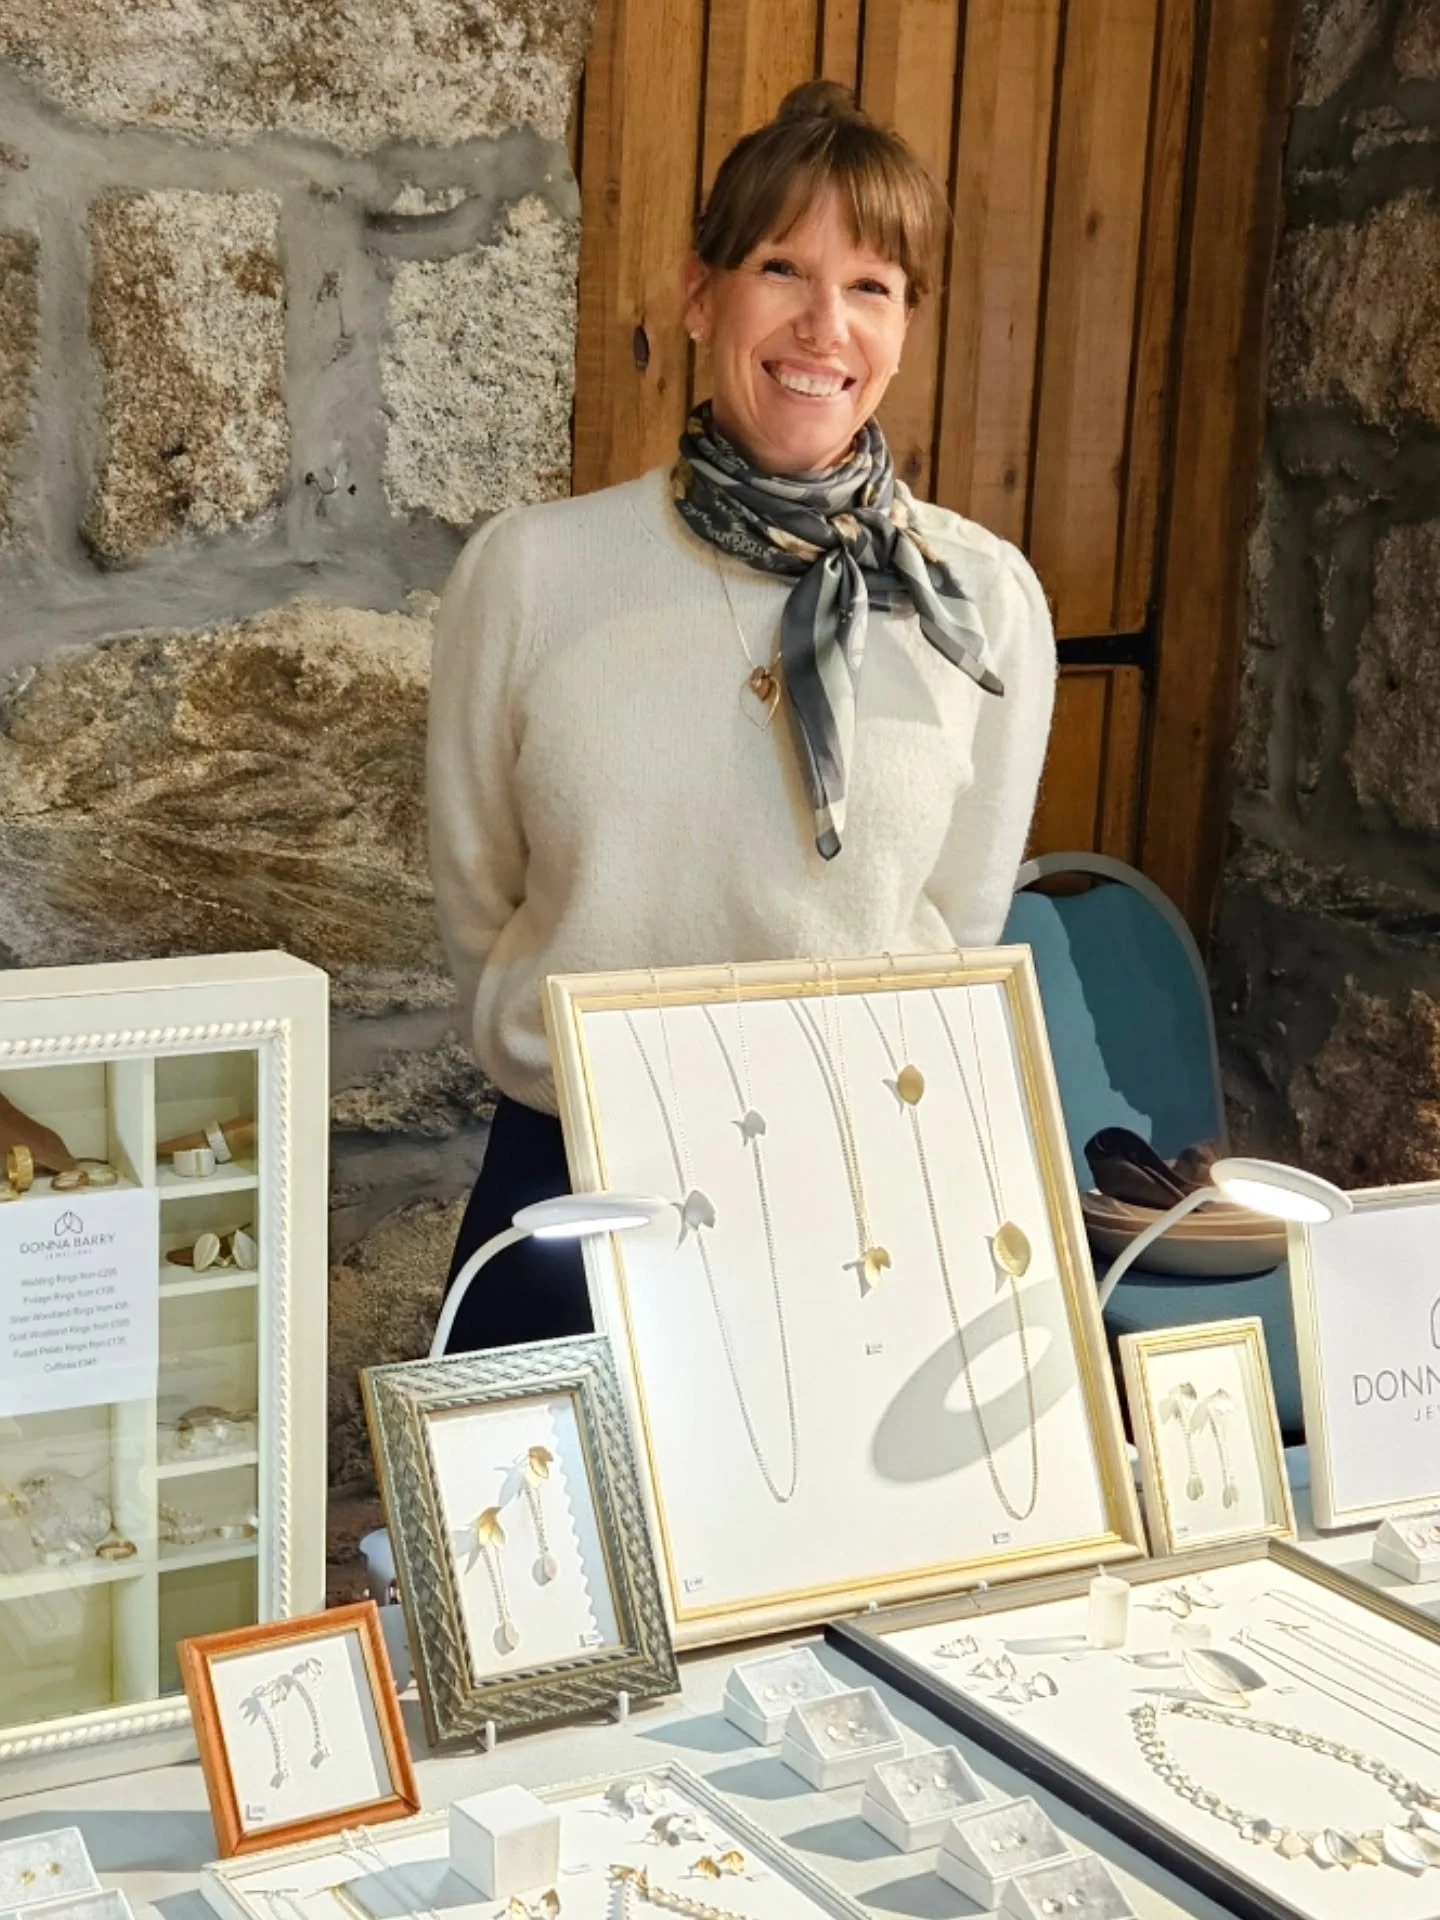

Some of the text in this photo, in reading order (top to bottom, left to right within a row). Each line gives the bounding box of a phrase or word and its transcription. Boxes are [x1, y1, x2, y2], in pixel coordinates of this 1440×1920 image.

[20, 1232, 116, 1254] DONNA BARRY
[1413, 1405, 1440, 1422] JE
